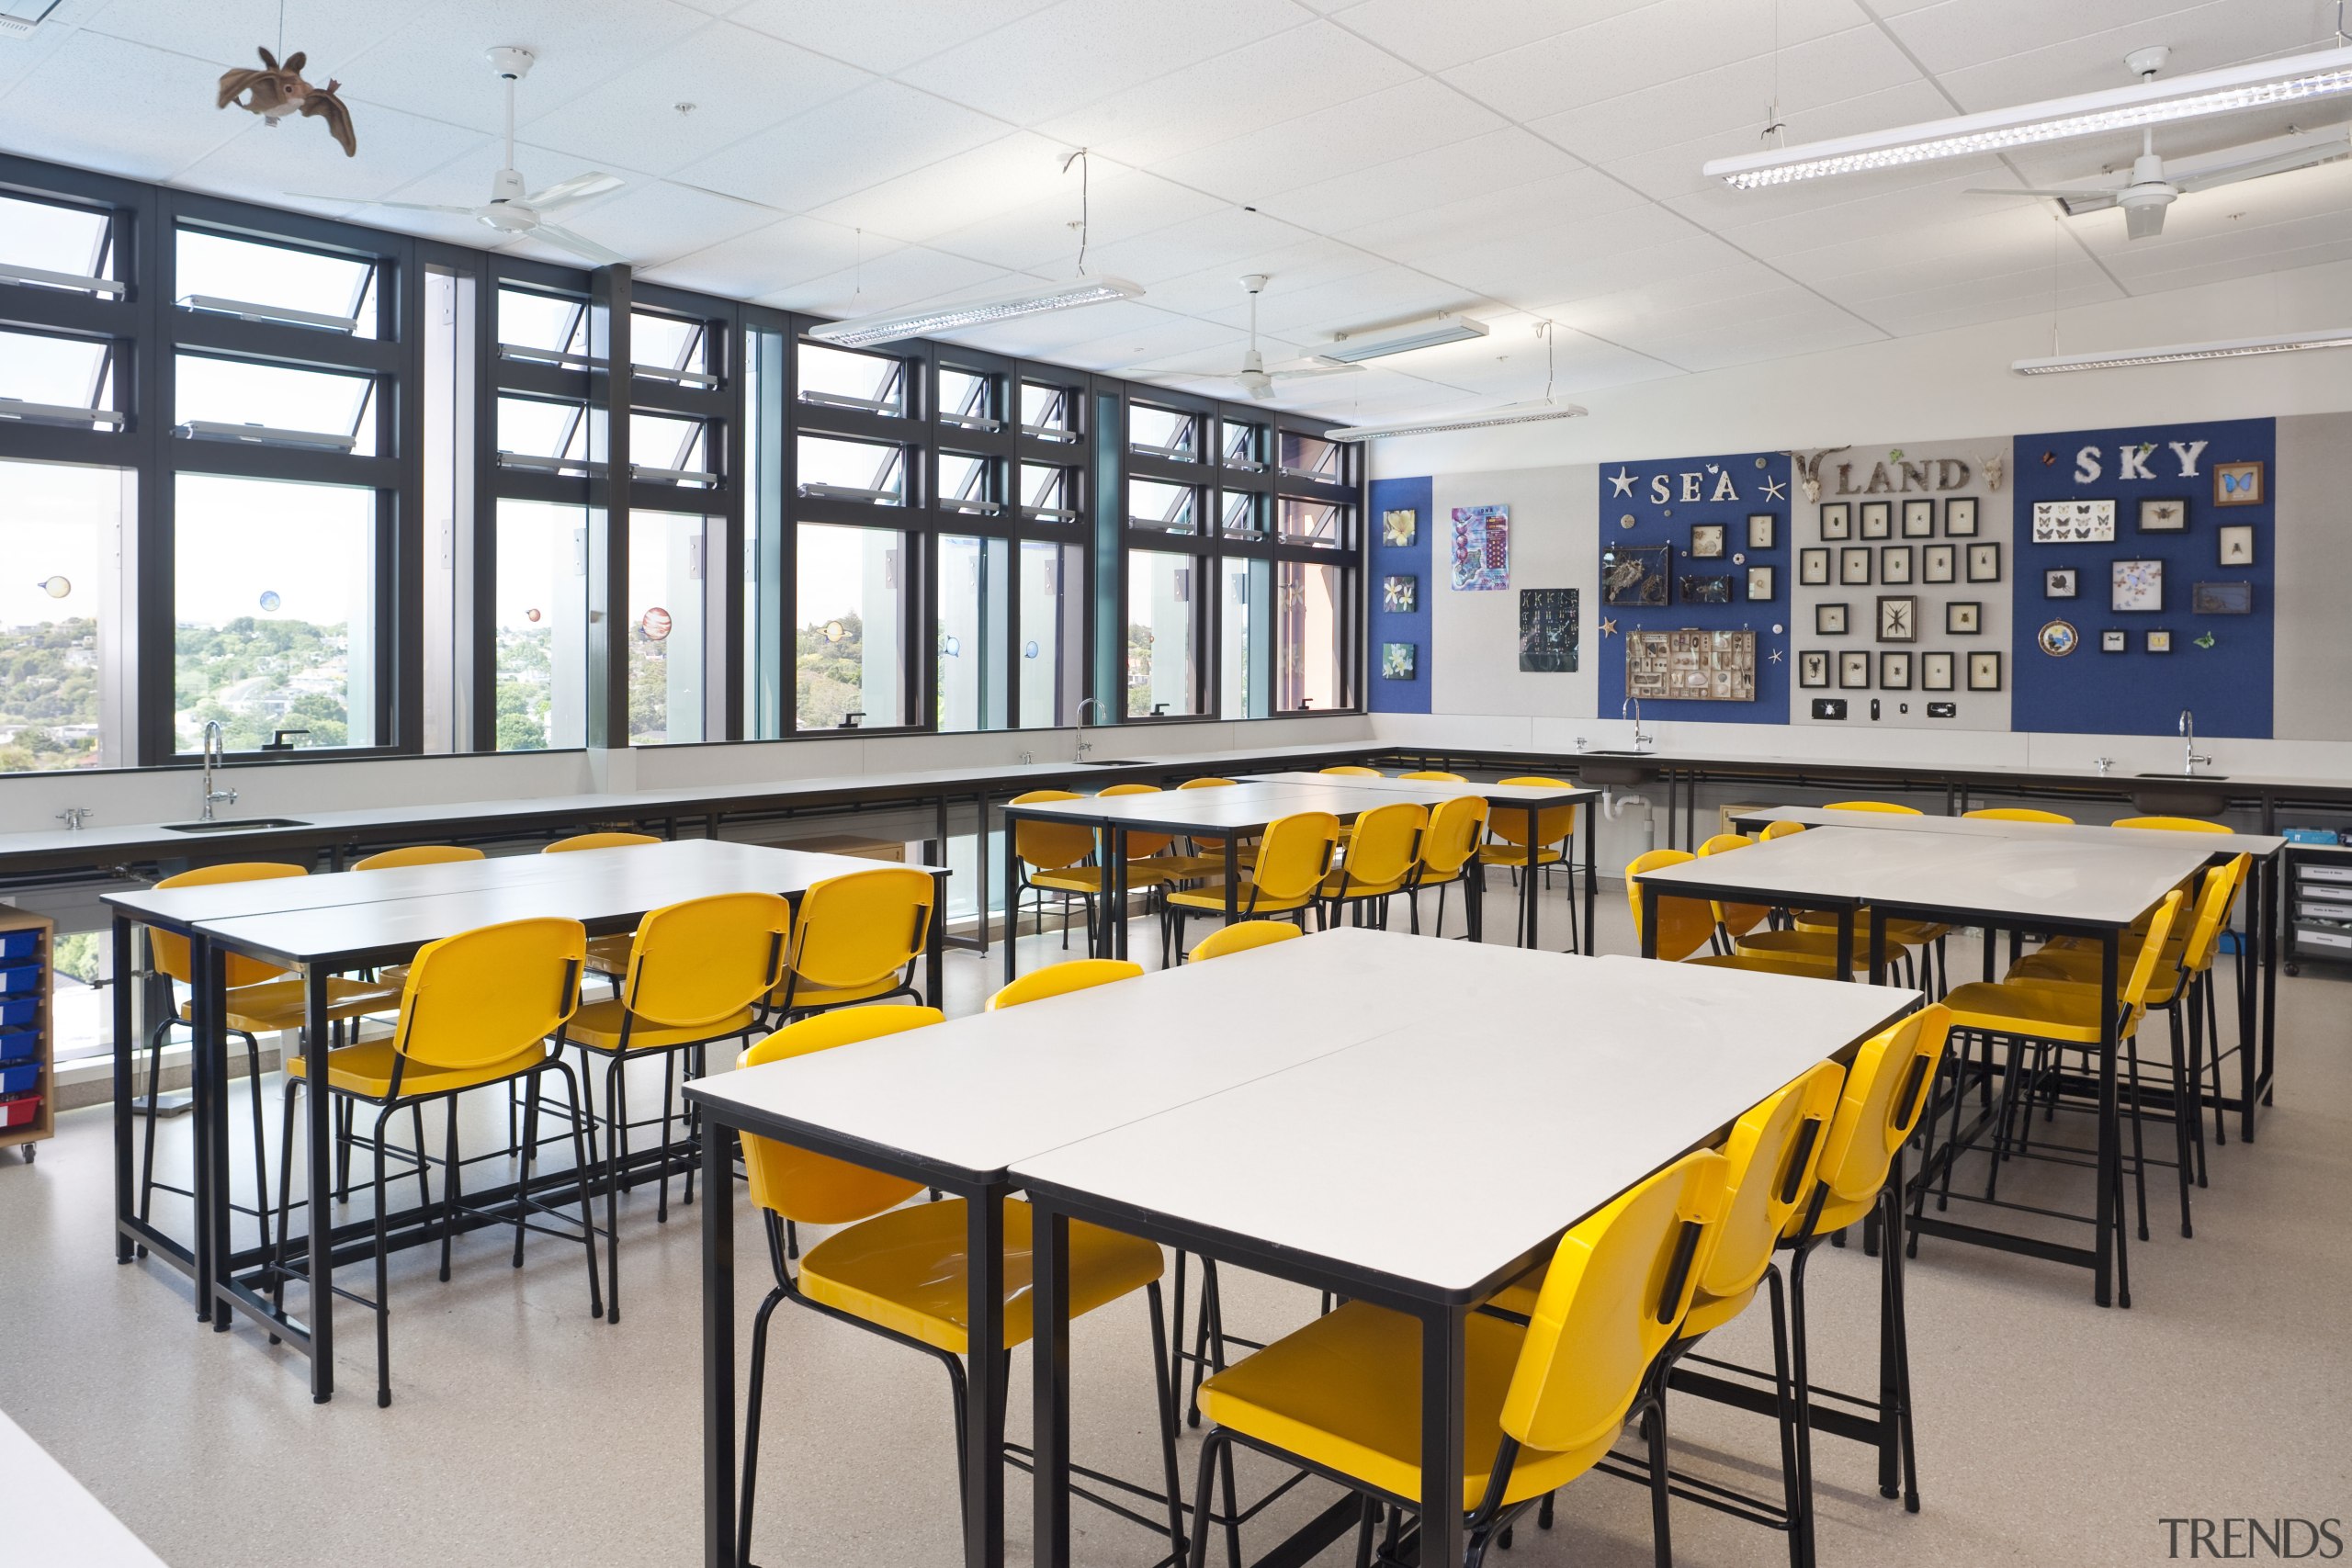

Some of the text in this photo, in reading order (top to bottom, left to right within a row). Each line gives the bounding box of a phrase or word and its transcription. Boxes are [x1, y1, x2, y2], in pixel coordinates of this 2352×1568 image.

[1836, 459, 1971, 495] LAND
[2075, 441, 2208, 484] SKY
[1650, 470, 1739, 504] SEA
